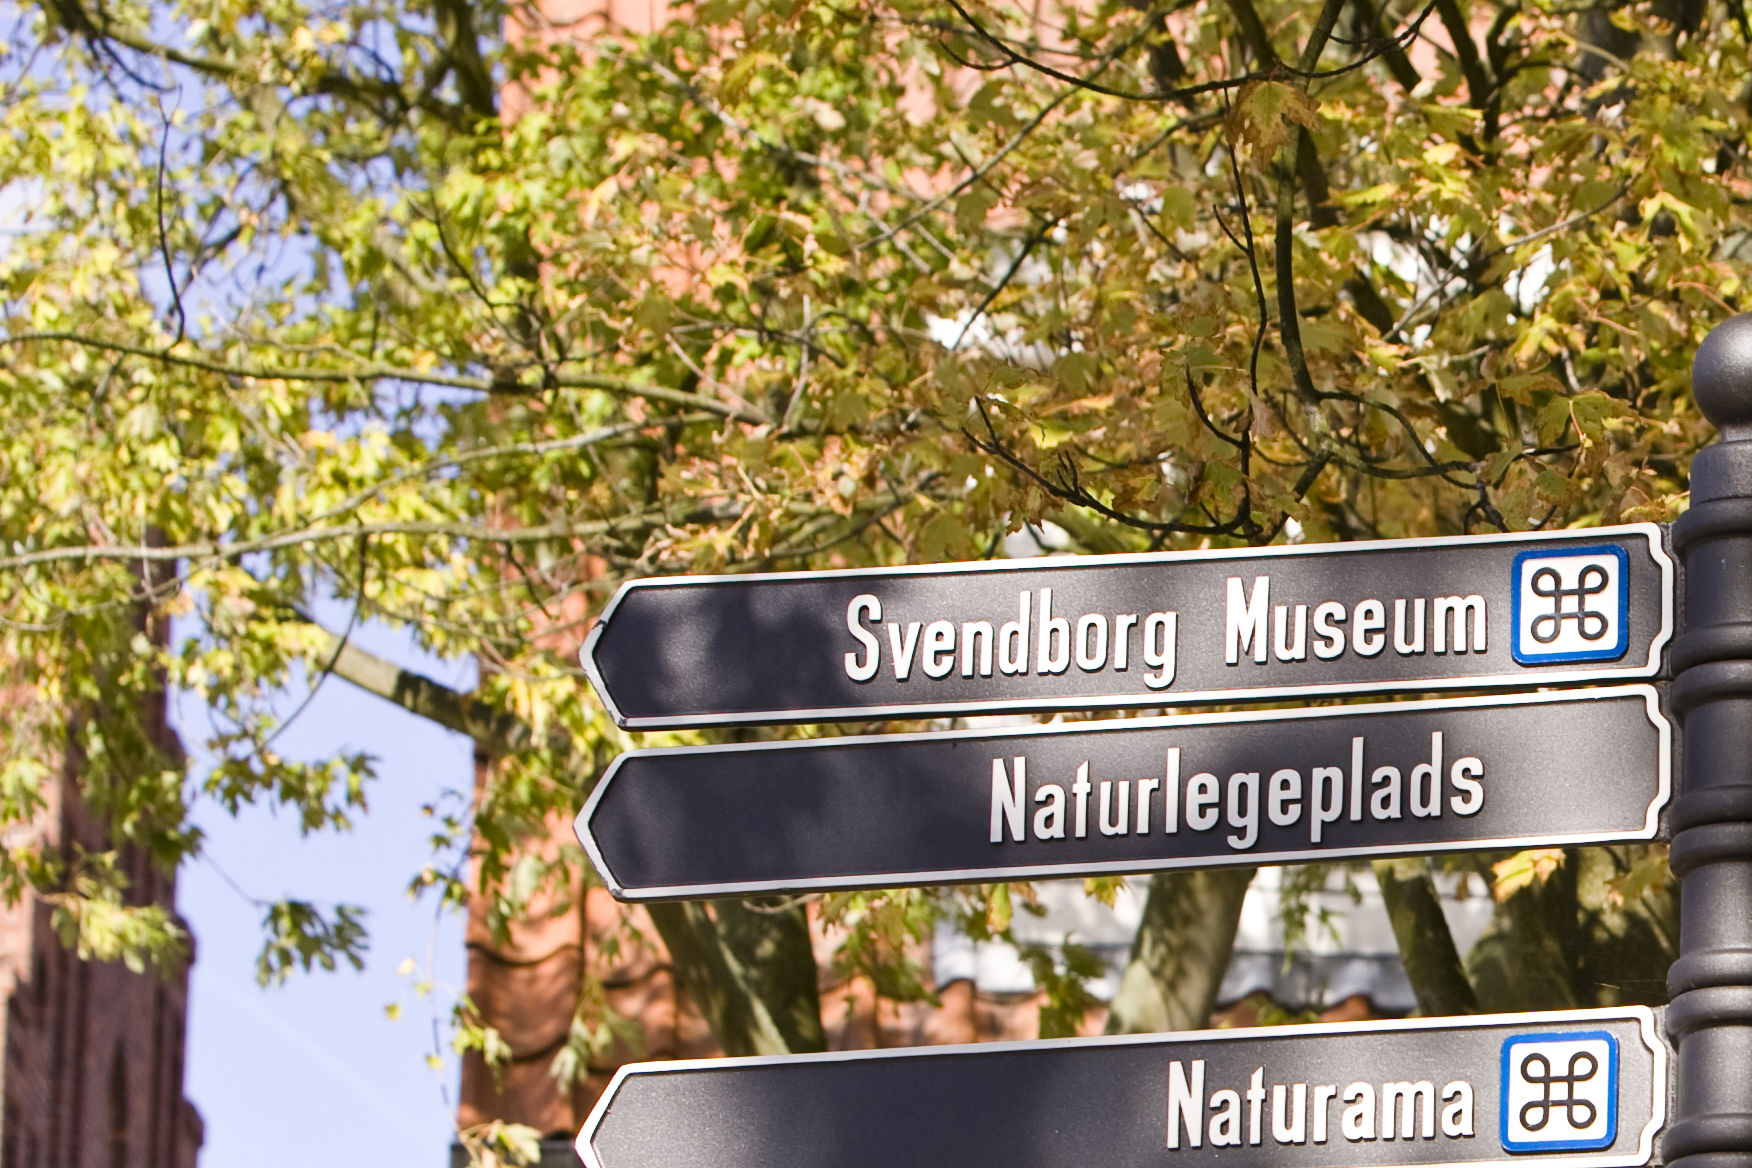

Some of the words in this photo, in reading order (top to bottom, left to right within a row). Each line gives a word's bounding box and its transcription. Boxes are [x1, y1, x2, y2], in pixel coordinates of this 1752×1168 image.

[845, 588, 1178, 689] Svendborg
[1226, 576, 1488, 665] Museum
[990, 731, 1487, 850] Naturlegeplads
[1166, 1059, 1476, 1151] Naturama
